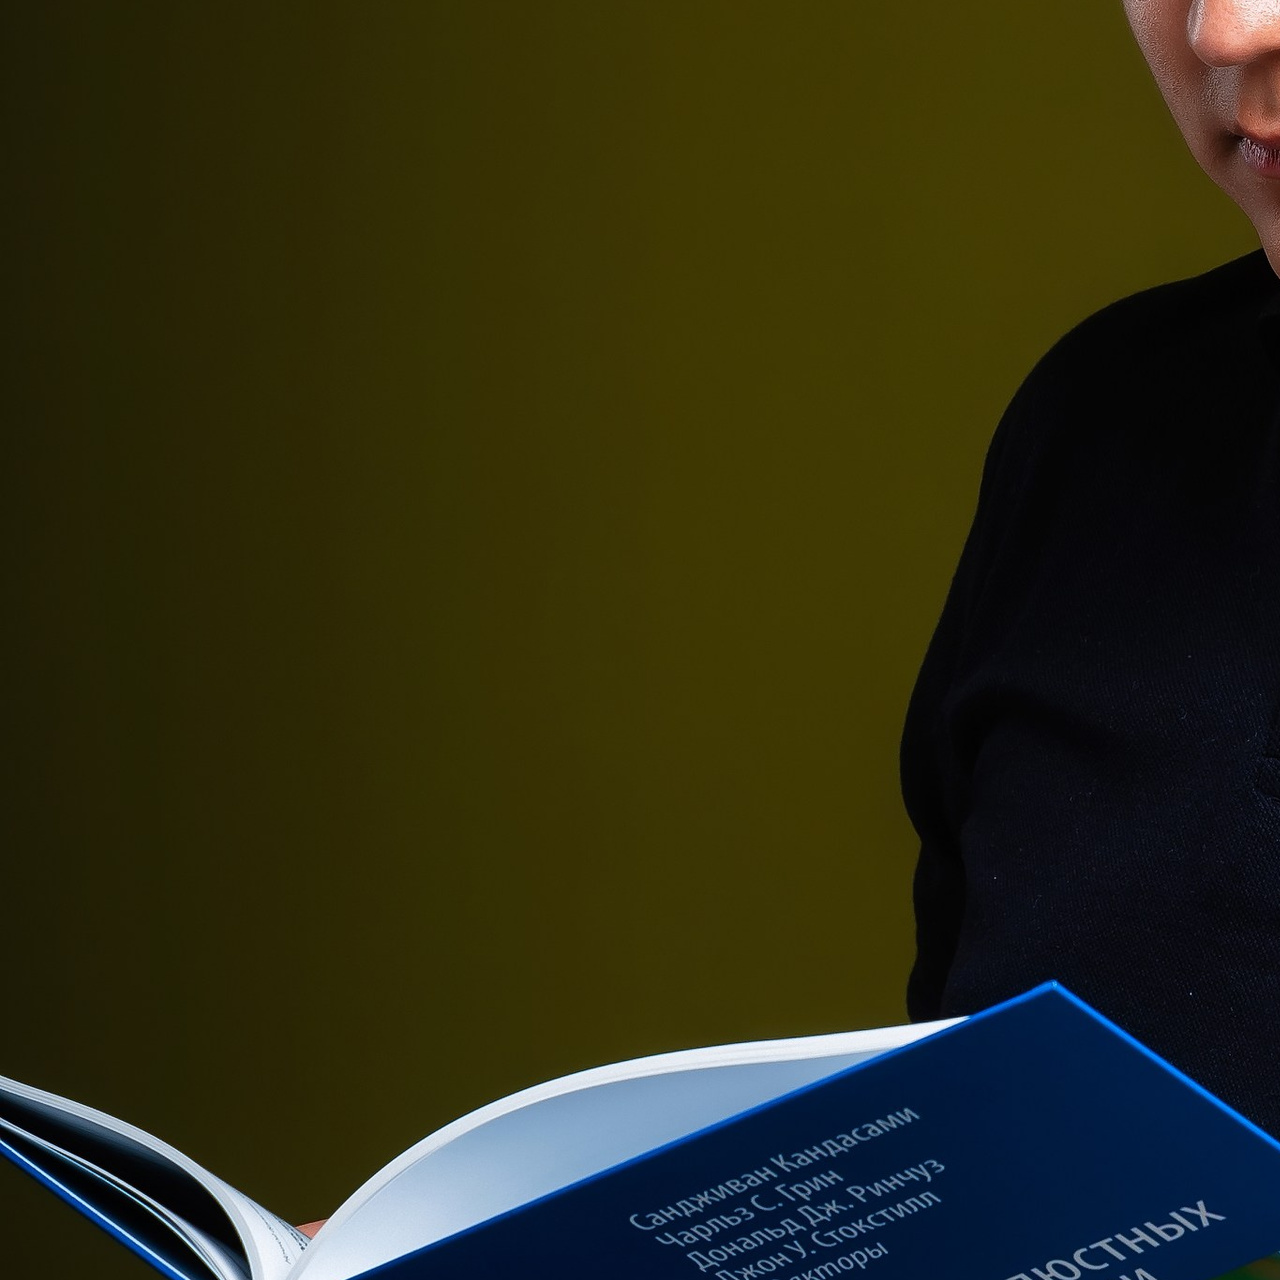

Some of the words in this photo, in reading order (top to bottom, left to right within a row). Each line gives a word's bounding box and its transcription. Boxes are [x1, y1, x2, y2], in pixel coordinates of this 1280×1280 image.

[629, 1165, 778, 1231] Сандживан
[770, 1107, 920, 1172] Кандасами
[655, 1207, 755, 1248] Чарльз
[750, 1194, 783, 1212] С.
[776, 1170, 844, 1203] Грин
[686, 1218, 804, 1272] Дональд
[797, 1201, 854, 1228] Дж.
[846, 1158, 945, 1202] Ринчуз
[793, 1240, 817, 1259] У.
[811, 1190, 942, 1247] Стокстилл
